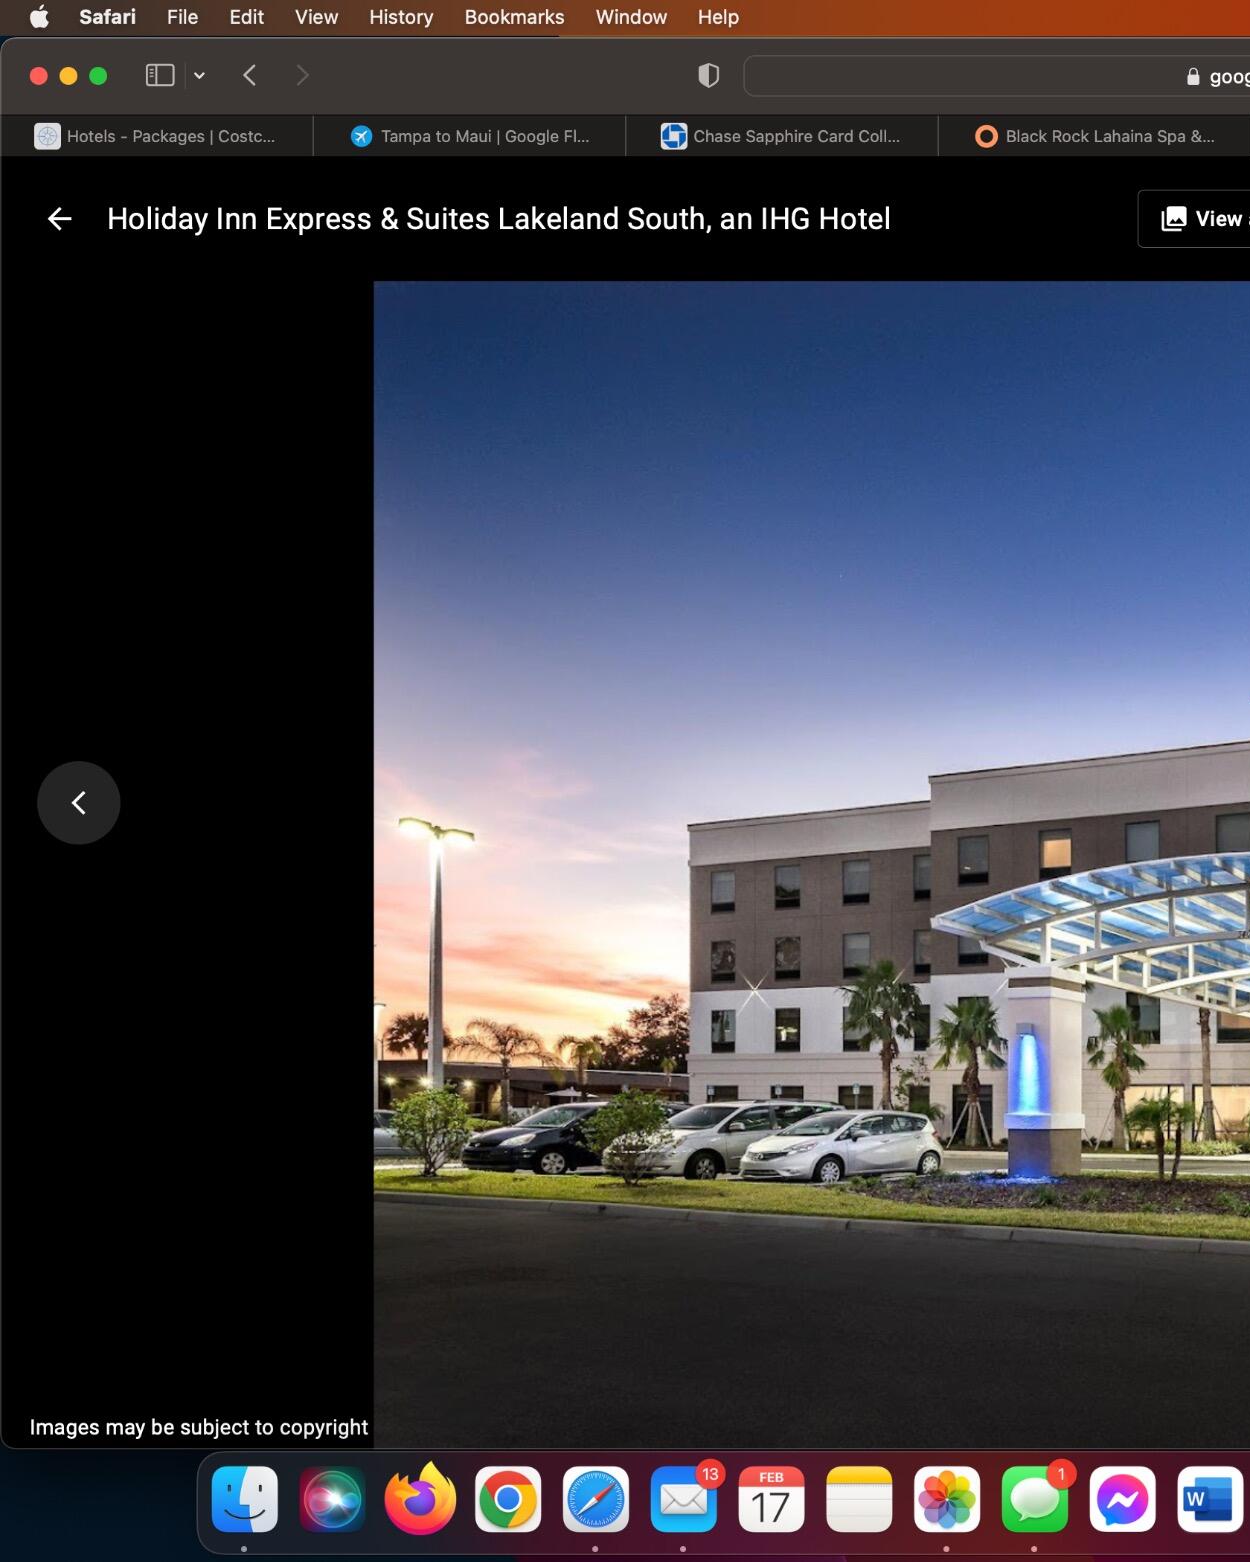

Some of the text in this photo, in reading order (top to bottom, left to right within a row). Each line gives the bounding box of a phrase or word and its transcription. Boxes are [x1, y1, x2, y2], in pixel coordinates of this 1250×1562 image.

[79, 7, 740, 28] Safari File Edit View History Bookmarks Window Help
[67, 128, 116, 143] Hotels
[133, 129, 206, 146] Packages
[380, 129, 431, 146] Tampa
[435, 130, 451, 143] to
[455, 129, 492, 143] Maui
[505, 128, 560, 146] Google
[693, 129, 741, 143] Chase
[745, 129, 814, 146] Sapphire
[817, 128, 854, 144] Card
[1006, 128, 1048, 143] Black
[1052, 128, 1090, 143] Rock
[1094, 128, 1153, 143] Lahaina
[1157, 129, 1186, 146] Spa
[108, 205, 890, 237] Holiday Inn Express & Suites Lakeland South, an IHG Hotel
[1195, 209, 1244, 228] View
[30, 1417, 369, 1440] Images may be subject to copyright
[702, 1467, 719, 1481] 13
[759, 1471, 785, 1483] FEB
[1058, 1467, 1065, 1481] 1
[751, 1492, 790, 1523] 17
[1186, 1491, 1205, 1507] W
